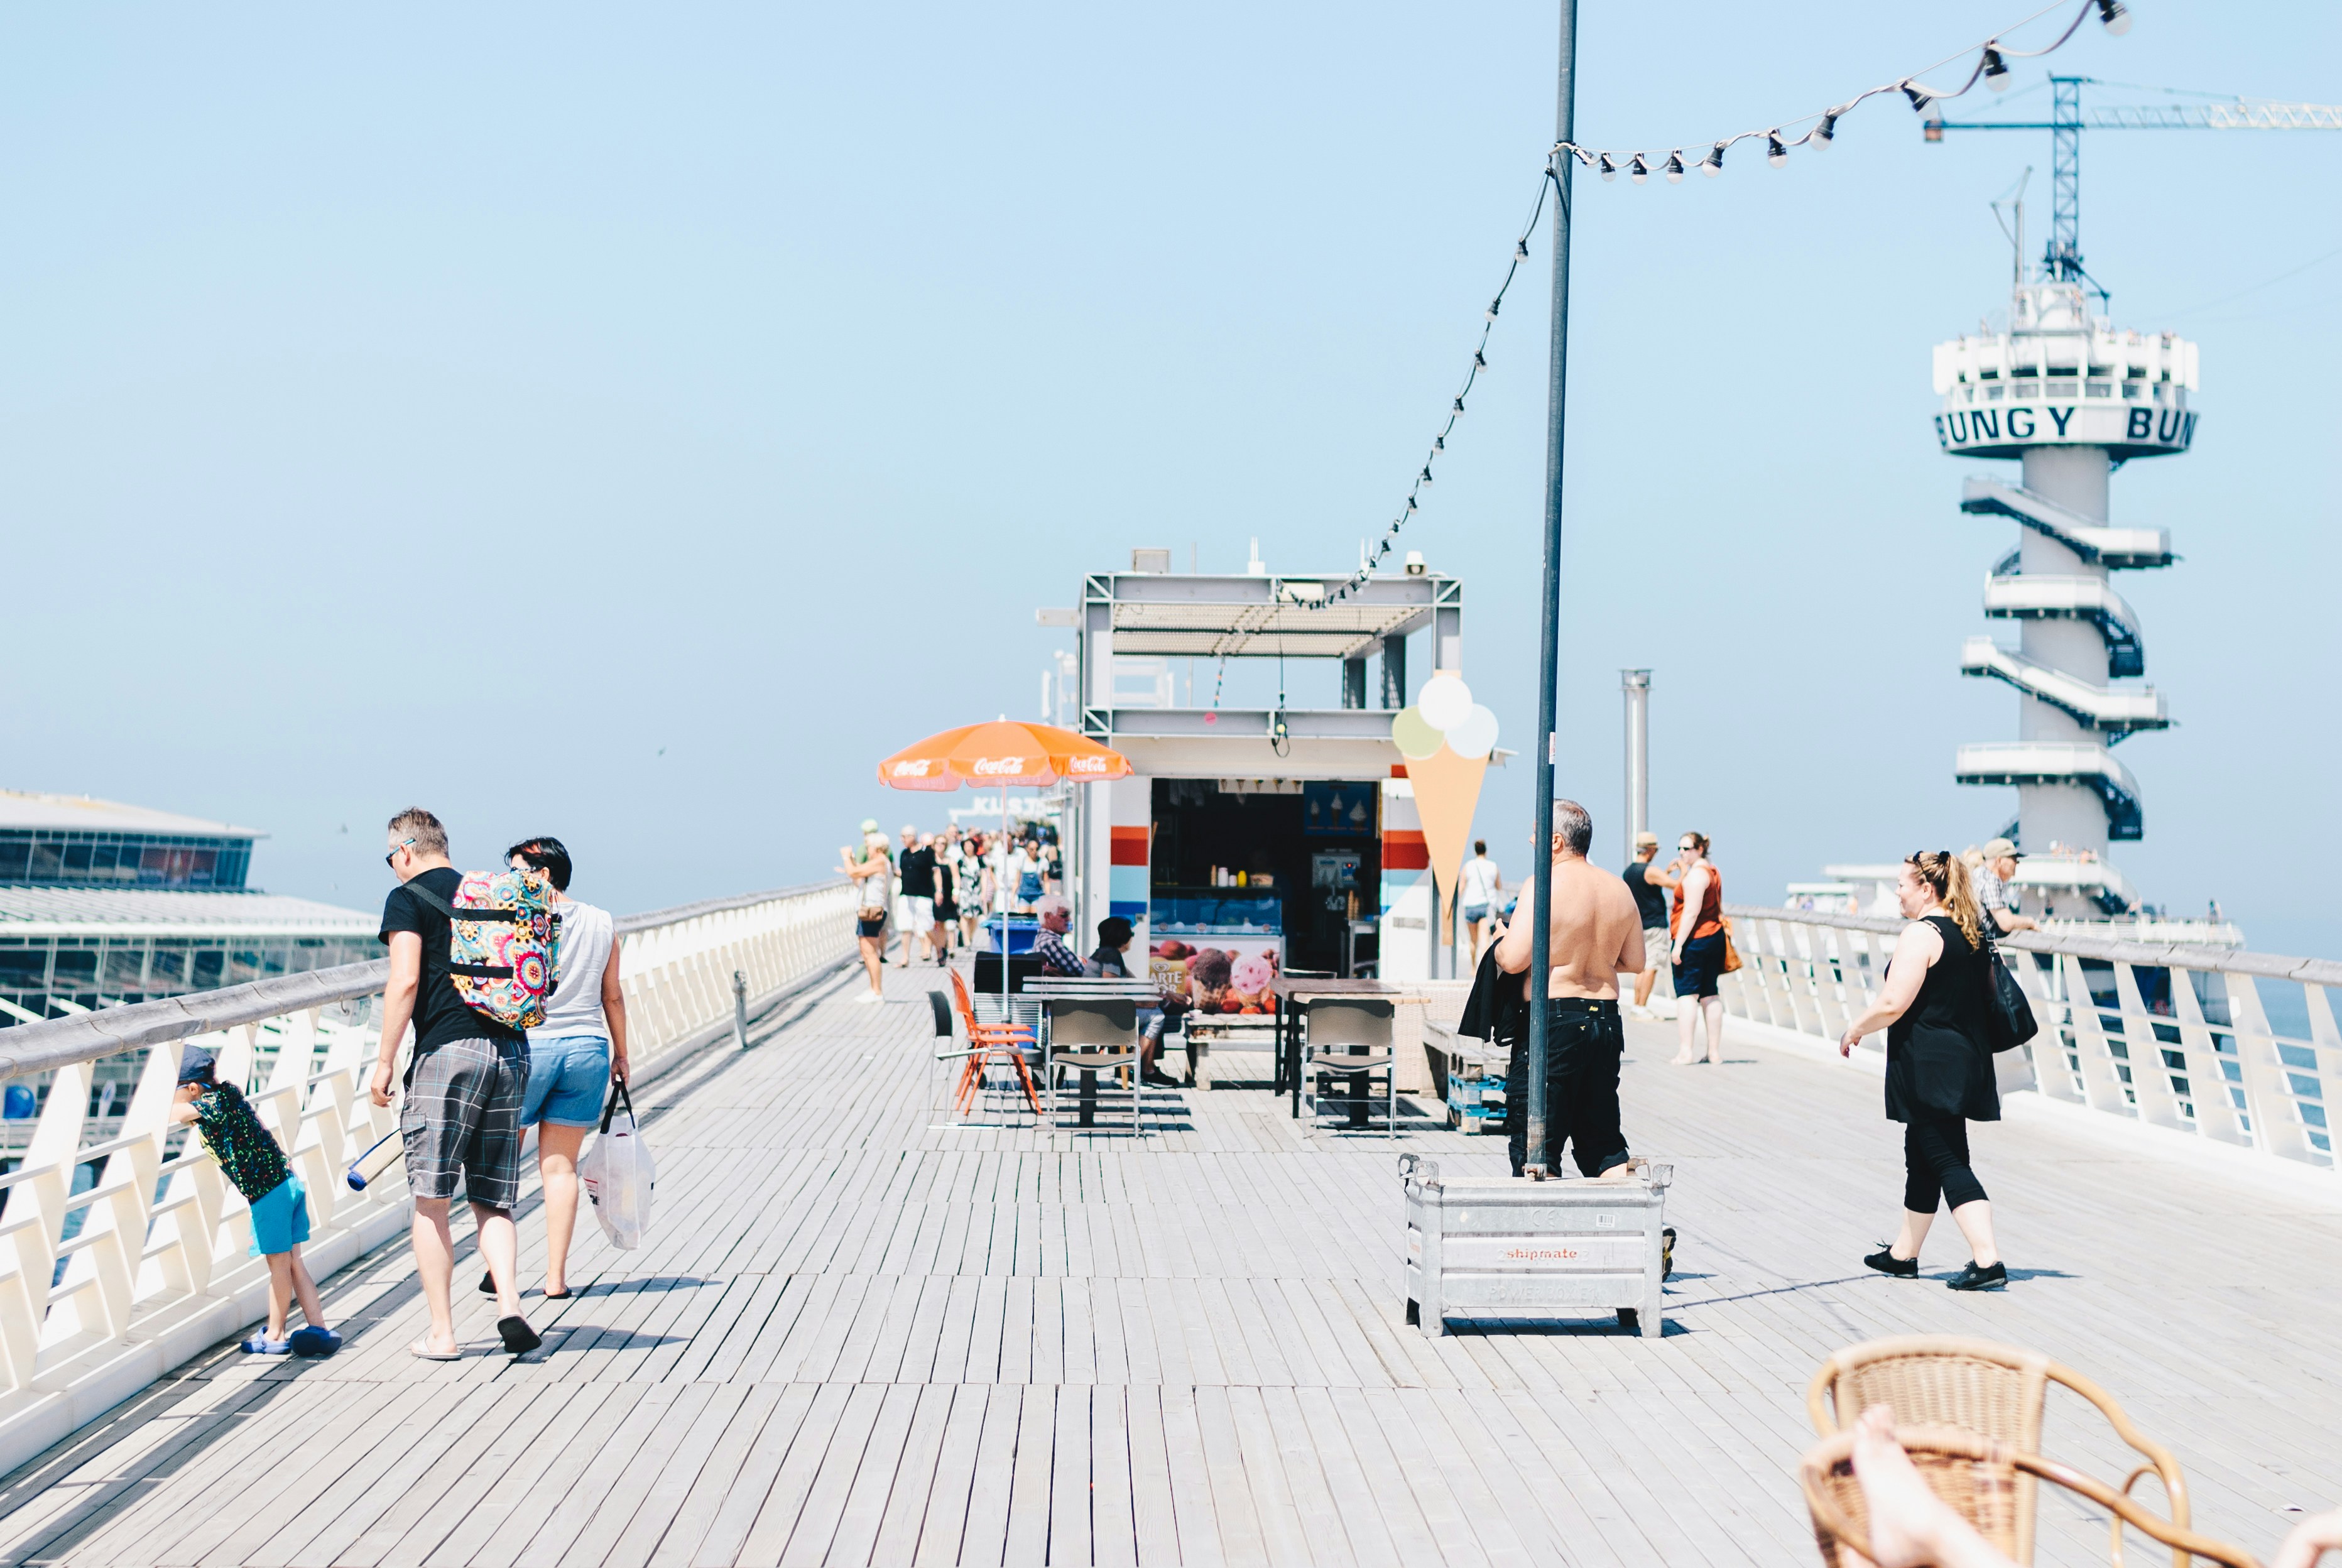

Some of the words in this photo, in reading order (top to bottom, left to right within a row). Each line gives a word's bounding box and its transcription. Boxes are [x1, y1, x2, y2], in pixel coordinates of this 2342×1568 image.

[2127, 407, 2198, 446] BUN
[1150, 971, 1182, 984] ARTE
[1507, 1248, 1577, 1260] shipmate
